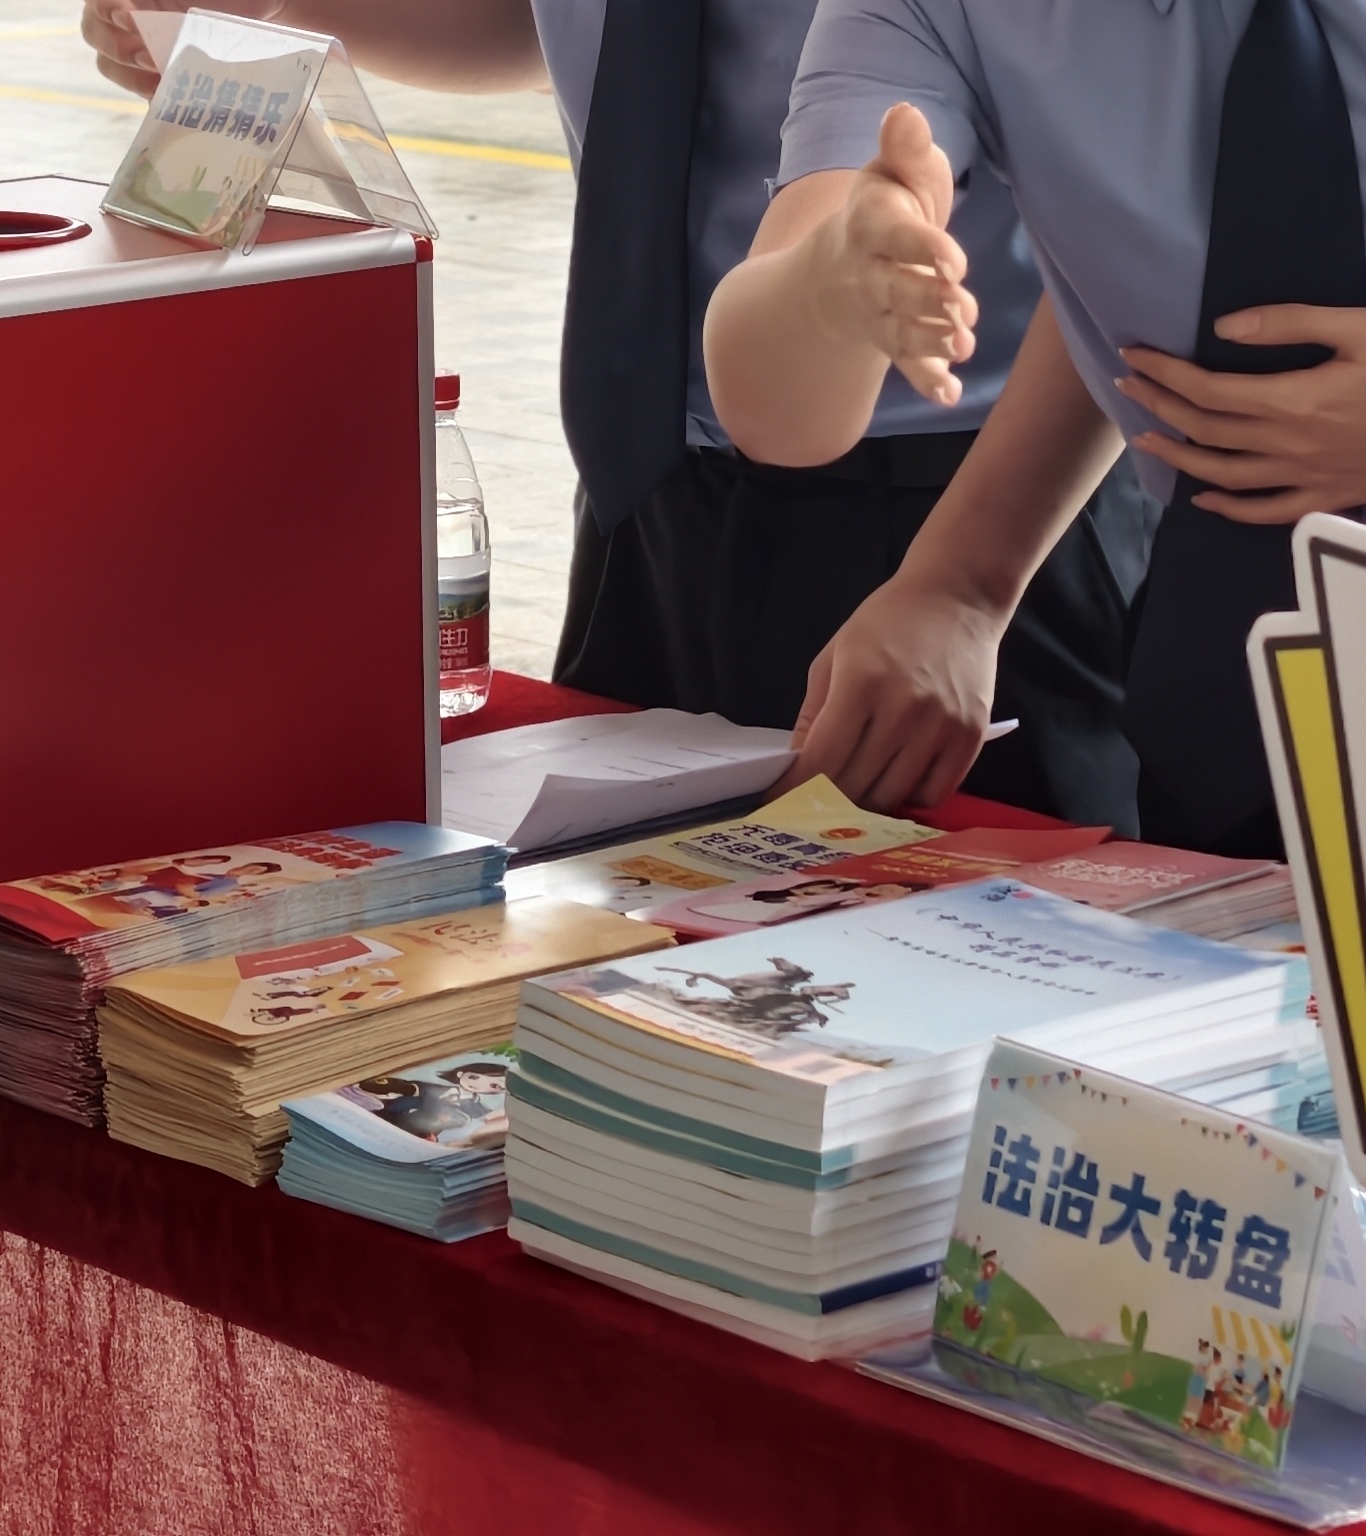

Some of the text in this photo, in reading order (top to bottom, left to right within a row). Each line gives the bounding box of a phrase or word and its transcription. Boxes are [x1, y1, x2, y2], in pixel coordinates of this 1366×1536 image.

[981, 1124, 1291, 1310] 法治大转盘
